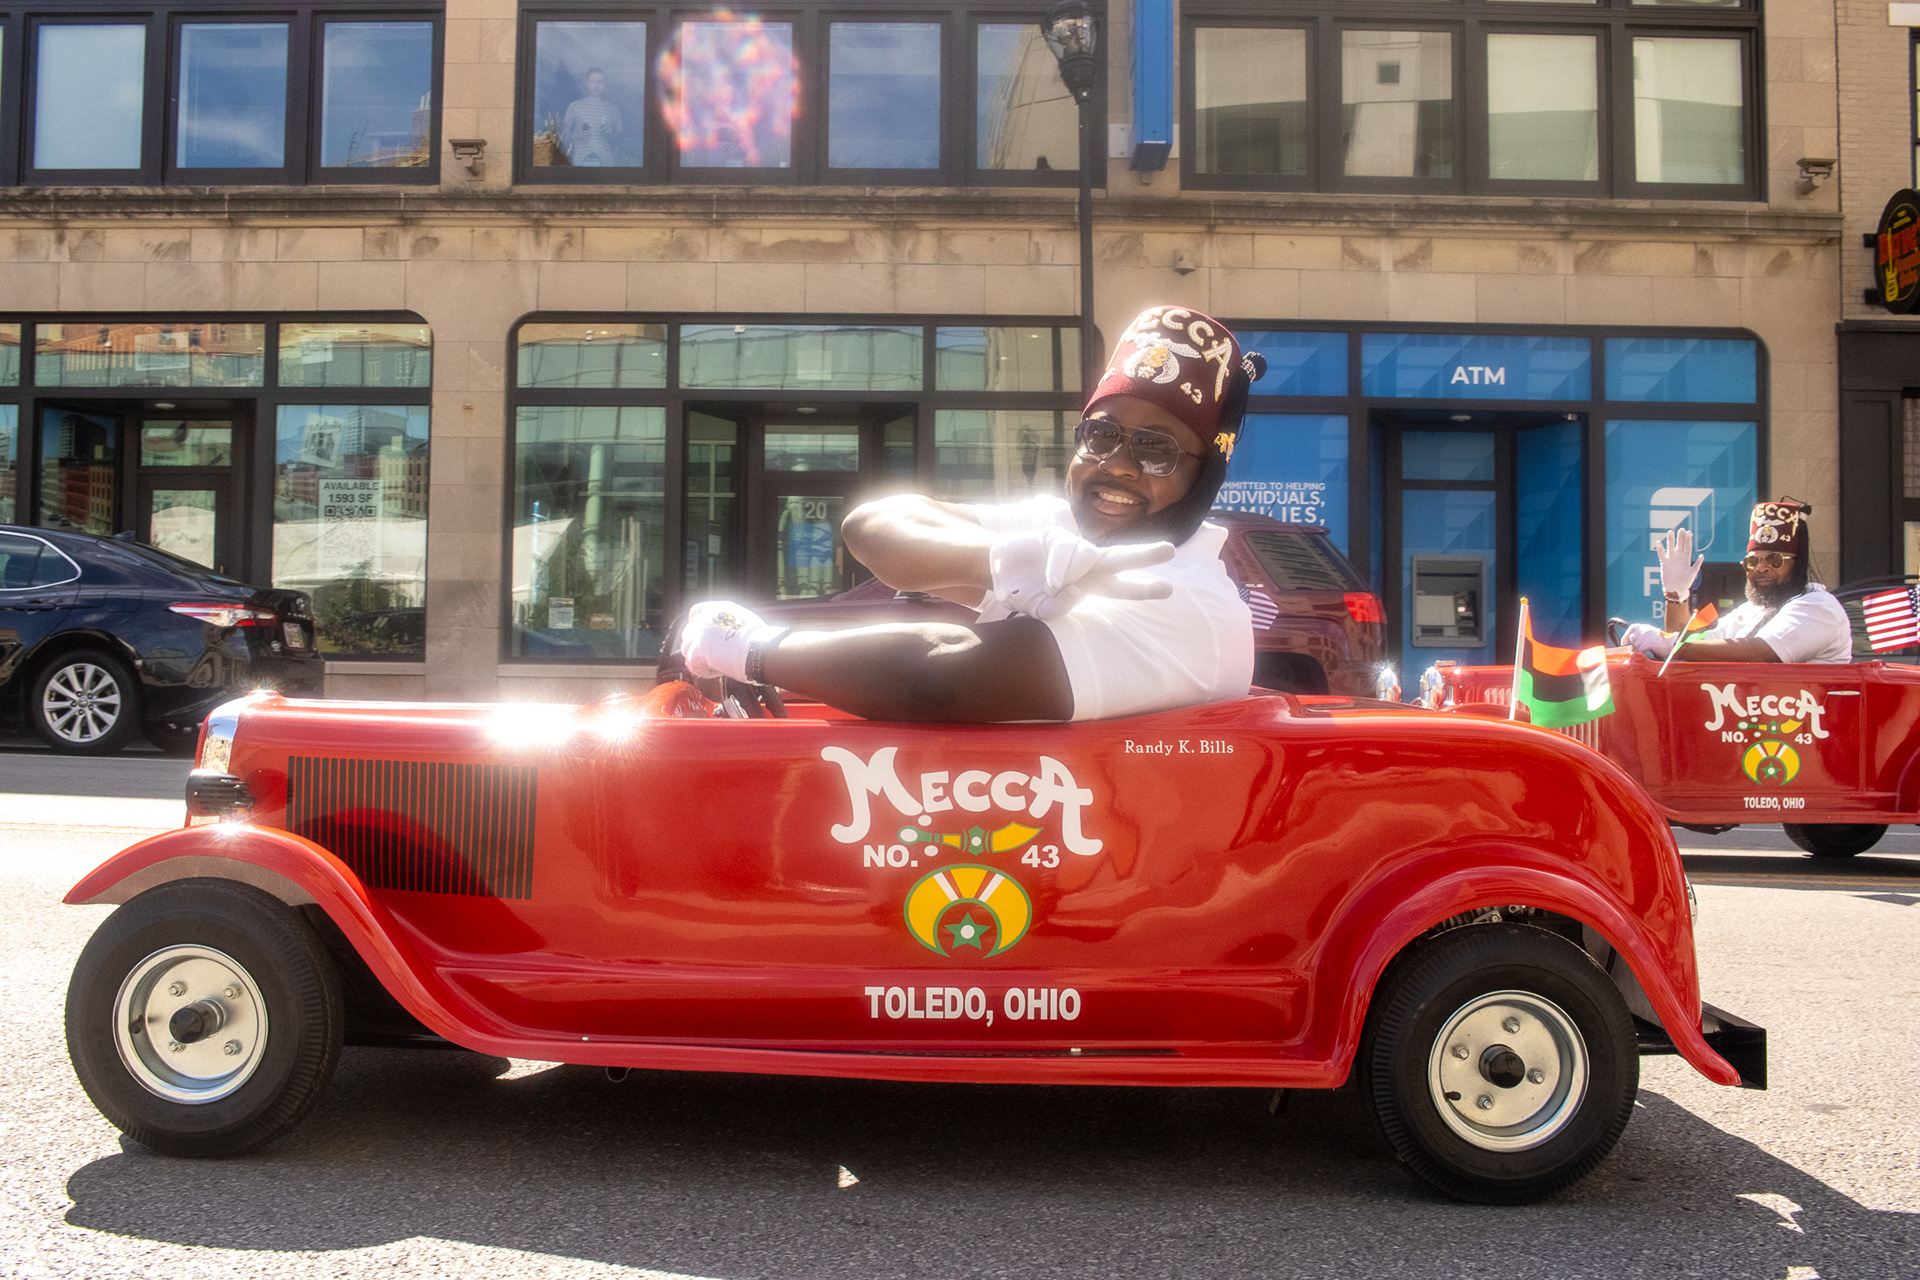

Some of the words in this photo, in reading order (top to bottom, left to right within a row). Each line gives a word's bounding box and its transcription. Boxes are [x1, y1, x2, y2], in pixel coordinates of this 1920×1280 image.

[1450, 366, 1506, 385] ATM
[1180, 382, 1203, 405] 43
[324, 482, 379, 490] AVAILABLE
[1220, 482, 1267, 490] MMITTED
[1269, 482, 1283, 490] TO
[1286, 483, 1326, 491] HELPING
[358, 494, 373, 503] SF
[1214, 490, 1326, 507] NDIVIDUALS,
[805, 502, 827, 519] 20
[1779, 534, 1792, 542] 43
[1700, 683, 1829, 739] MECCA
[1721, 731, 1748, 743] NO.
[1794, 733, 1813, 744] 43
[1124, 740, 1174, 756] Randy
[1178, 740, 1195, 753] K.
[1199, 740, 1234, 753] Bills
[820, 746, 1103, 856] MECCA
[1743, 797, 1781, 811] TOLEDO,
[1782, 797, 1806, 809] OHIO
[863, 844, 918, 868] NO.
[1021, 844, 1060, 868] 43
[865, 986, 994, 1028] TOLEDO,
[1003, 987, 1081, 1021] OHIO
